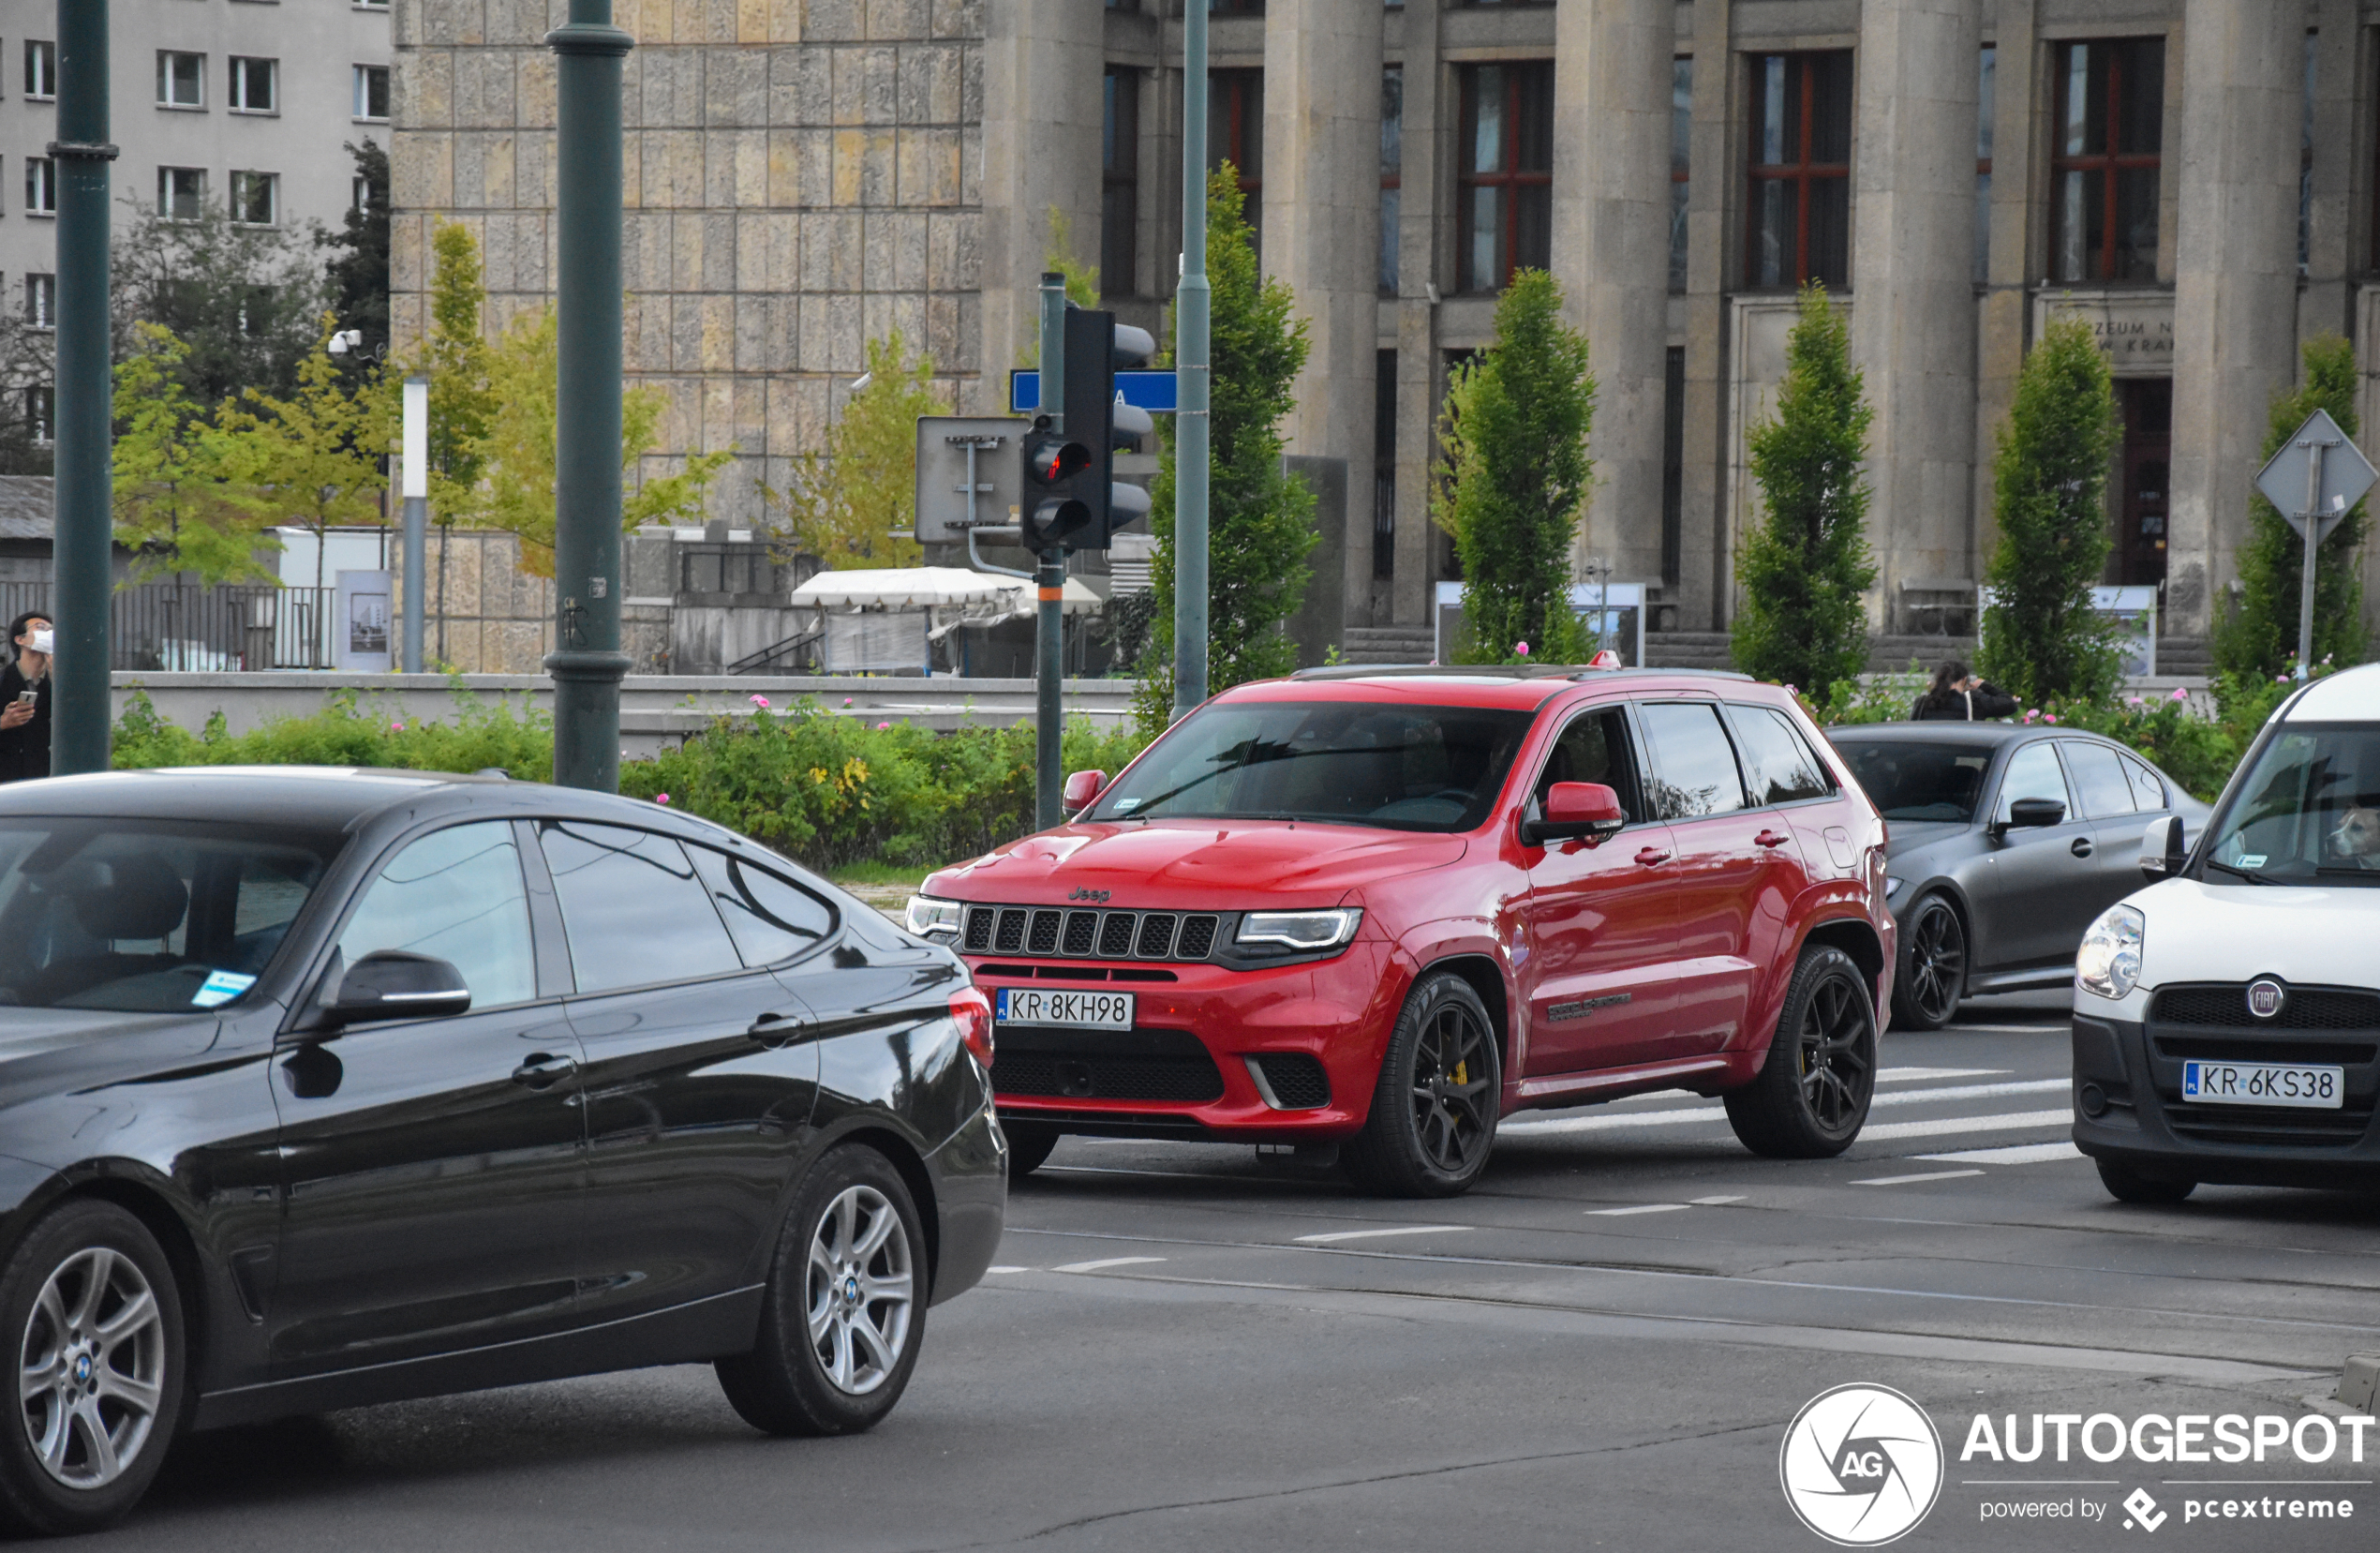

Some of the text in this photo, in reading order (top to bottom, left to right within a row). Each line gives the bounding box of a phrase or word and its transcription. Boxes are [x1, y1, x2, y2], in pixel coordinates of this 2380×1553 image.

[2094, 321, 2145, 336] ZEUM
[1113, 389, 1125, 405] A
[1068, 886, 1111, 904] Jeep
[998, 993, 1126, 1023] PL KR 8KH98
[2255, 991, 2276, 1008] FIAT
[2204, 1068, 2238, 1095] KR
[2249, 1069, 2334, 1098] 6KS38
